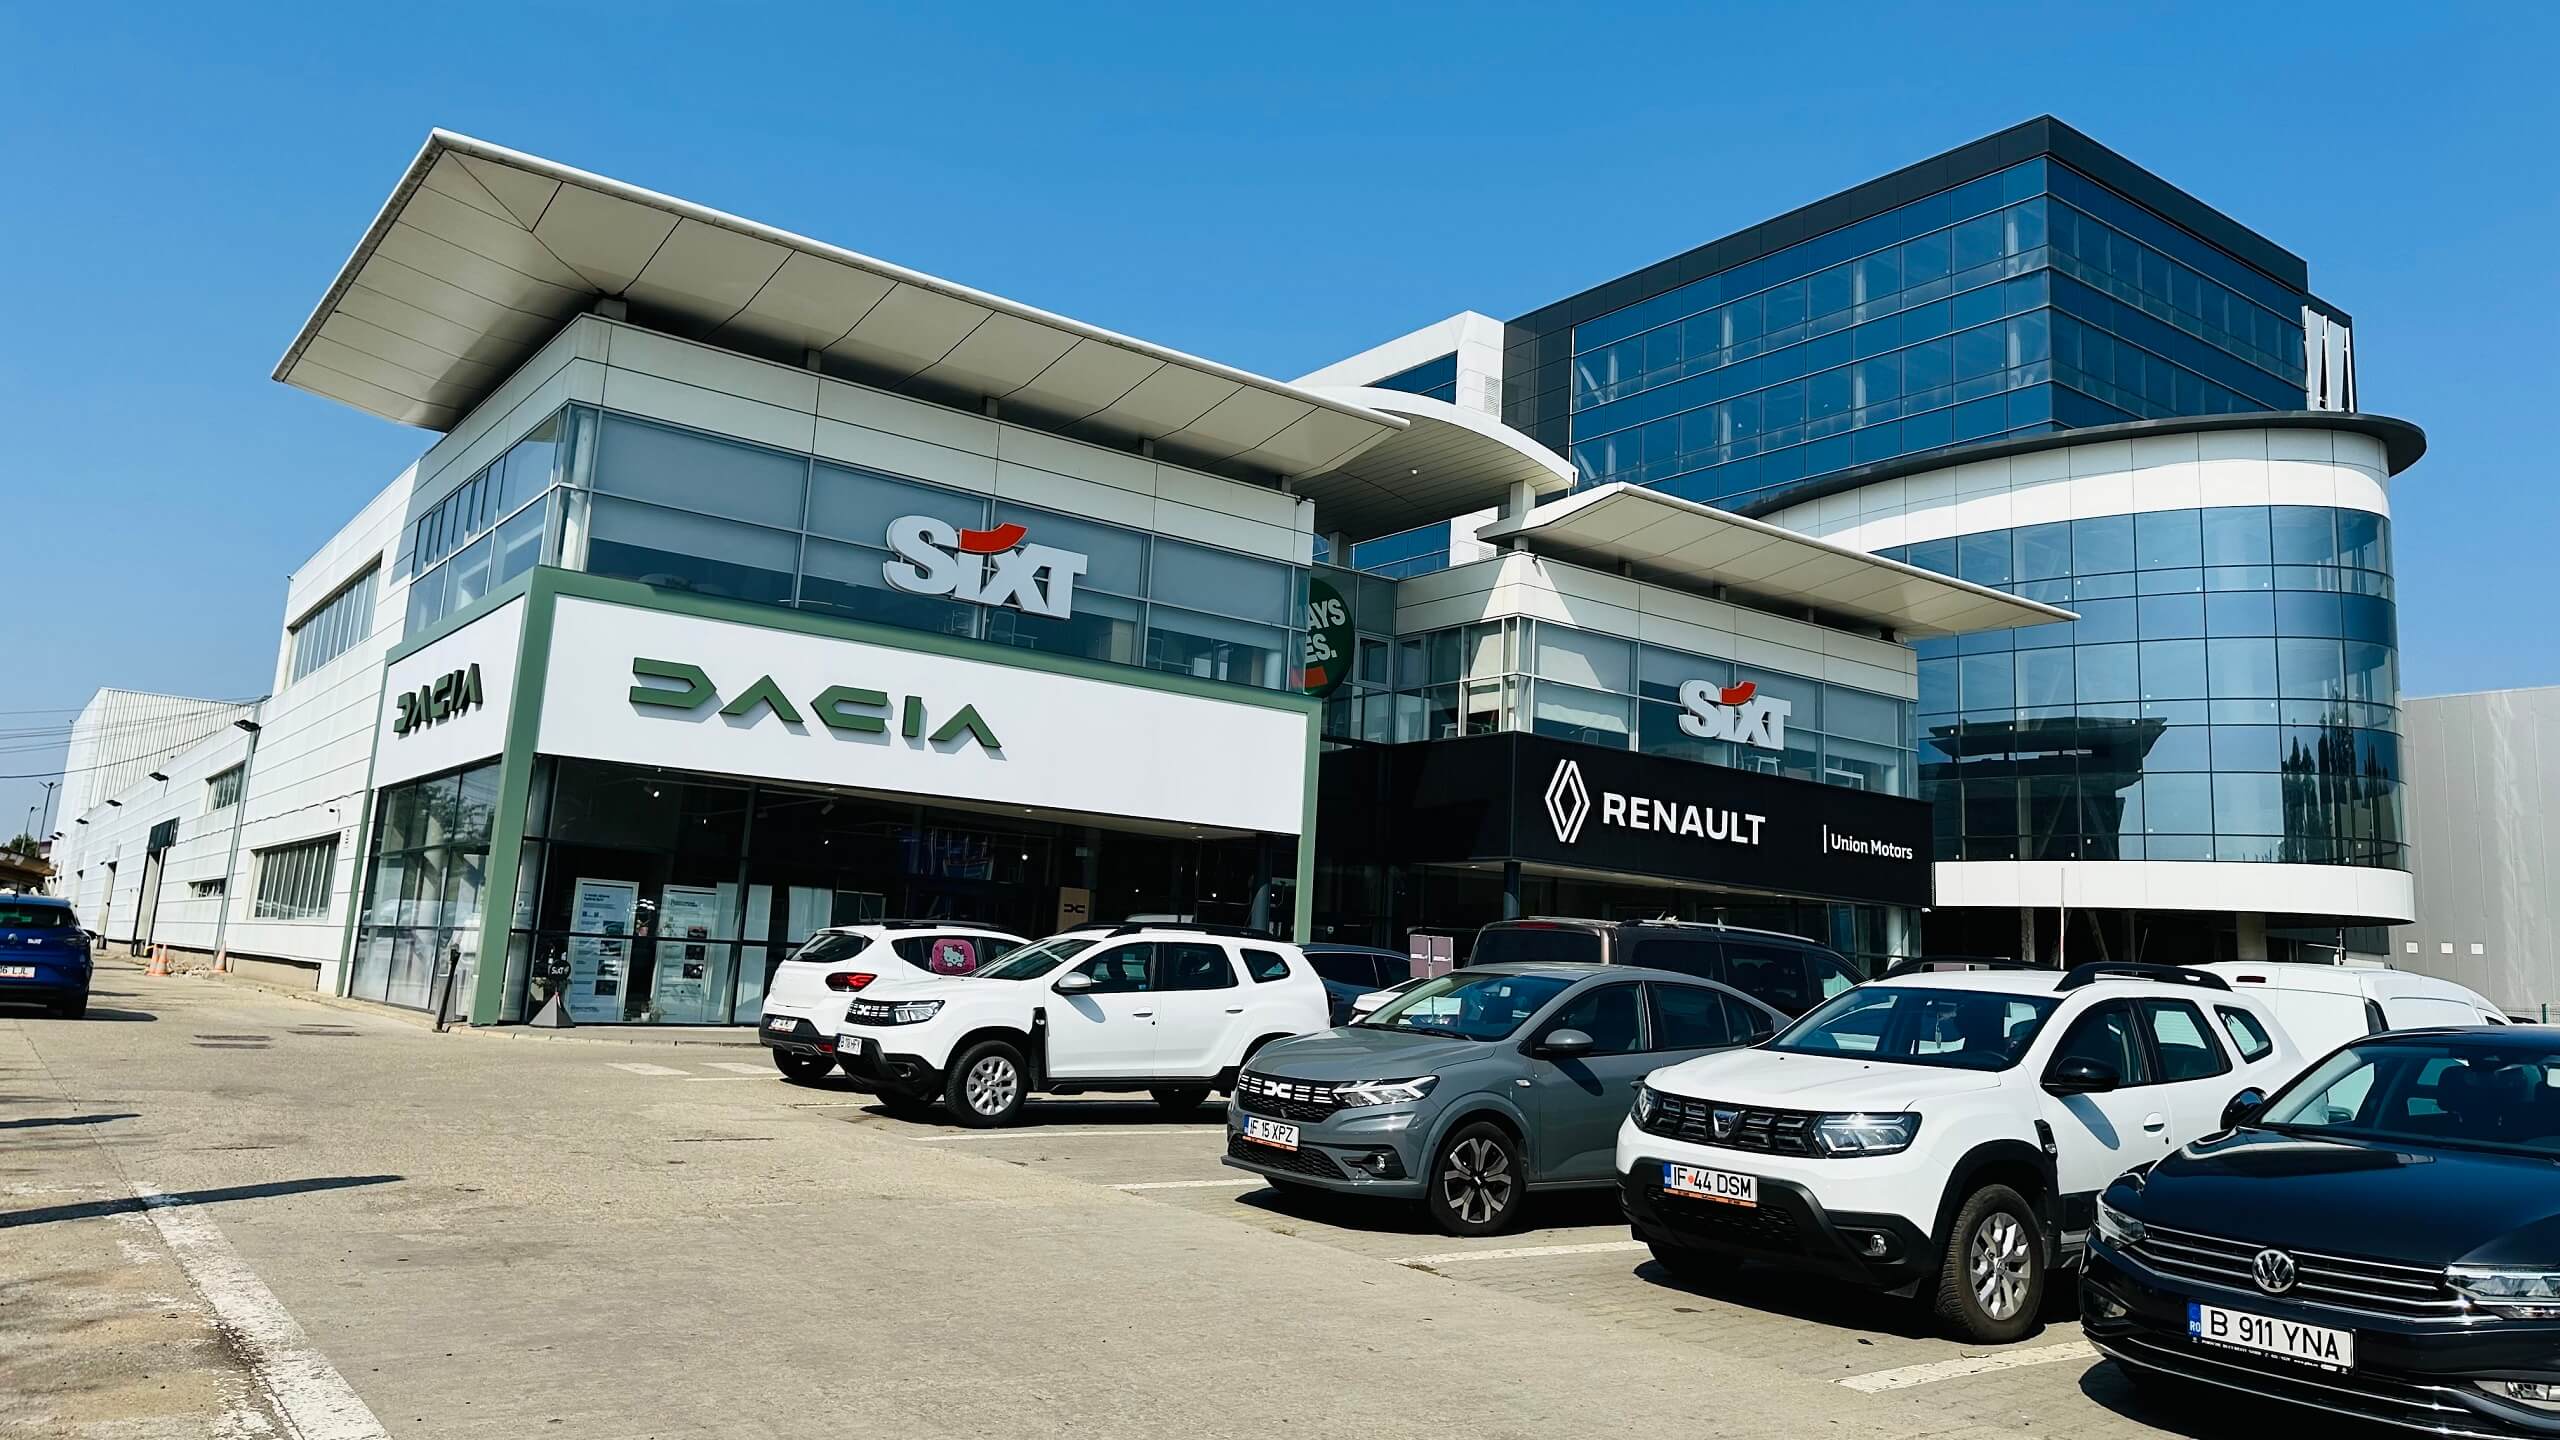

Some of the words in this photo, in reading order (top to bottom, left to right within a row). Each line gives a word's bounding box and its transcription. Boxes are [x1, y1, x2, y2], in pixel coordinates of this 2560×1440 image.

[393, 663, 483, 733] DACIA
[629, 657, 1002, 748] DACIA
[1603, 791, 1766, 845] RENAULT
[1831, 832, 1869, 854] Union
[1870, 839, 1913, 860] Motors
[1250, 1119, 1258, 1135] IF
[1262, 1121, 1270, 1138] 15
[1272, 1124, 1294, 1143] XPZ
[1673, 1166, 1688, 1186] IF
[1693, 1170, 1712, 1191] 44
[1716, 1173, 1752, 1198] DSM
[2189, 1320, 2201, 1333] RO
[2210, 1310, 2228, 1337] B
[2239, 1316, 2273, 1347] 911
[2282, 1323, 2340, 1361] YNA
